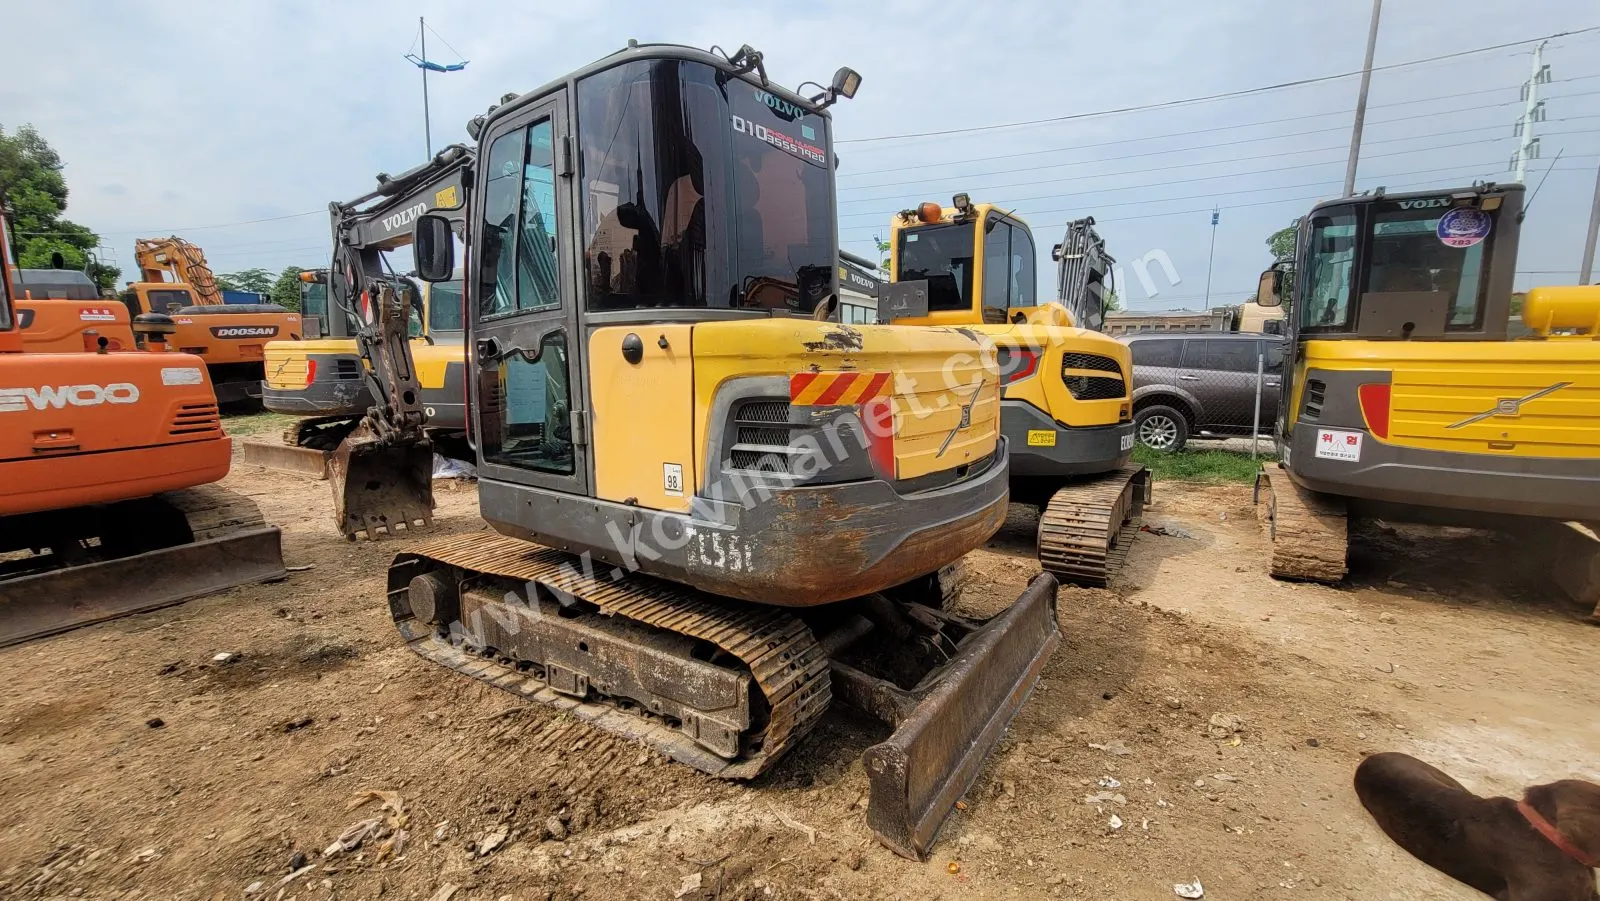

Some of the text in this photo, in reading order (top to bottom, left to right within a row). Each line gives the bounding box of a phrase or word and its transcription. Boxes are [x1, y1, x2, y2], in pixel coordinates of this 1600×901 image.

[754, 90, 804, 121] VOLVO
[732, 115, 768, 141] 010
[1398, 198, 1453, 210] VOLV
[382, 202, 427, 232] VOLVO
[851, 273, 874, 289] VOLVO
[217, 327, 275, 337] DOOSAN
[667, 474, 678, 489] 98
